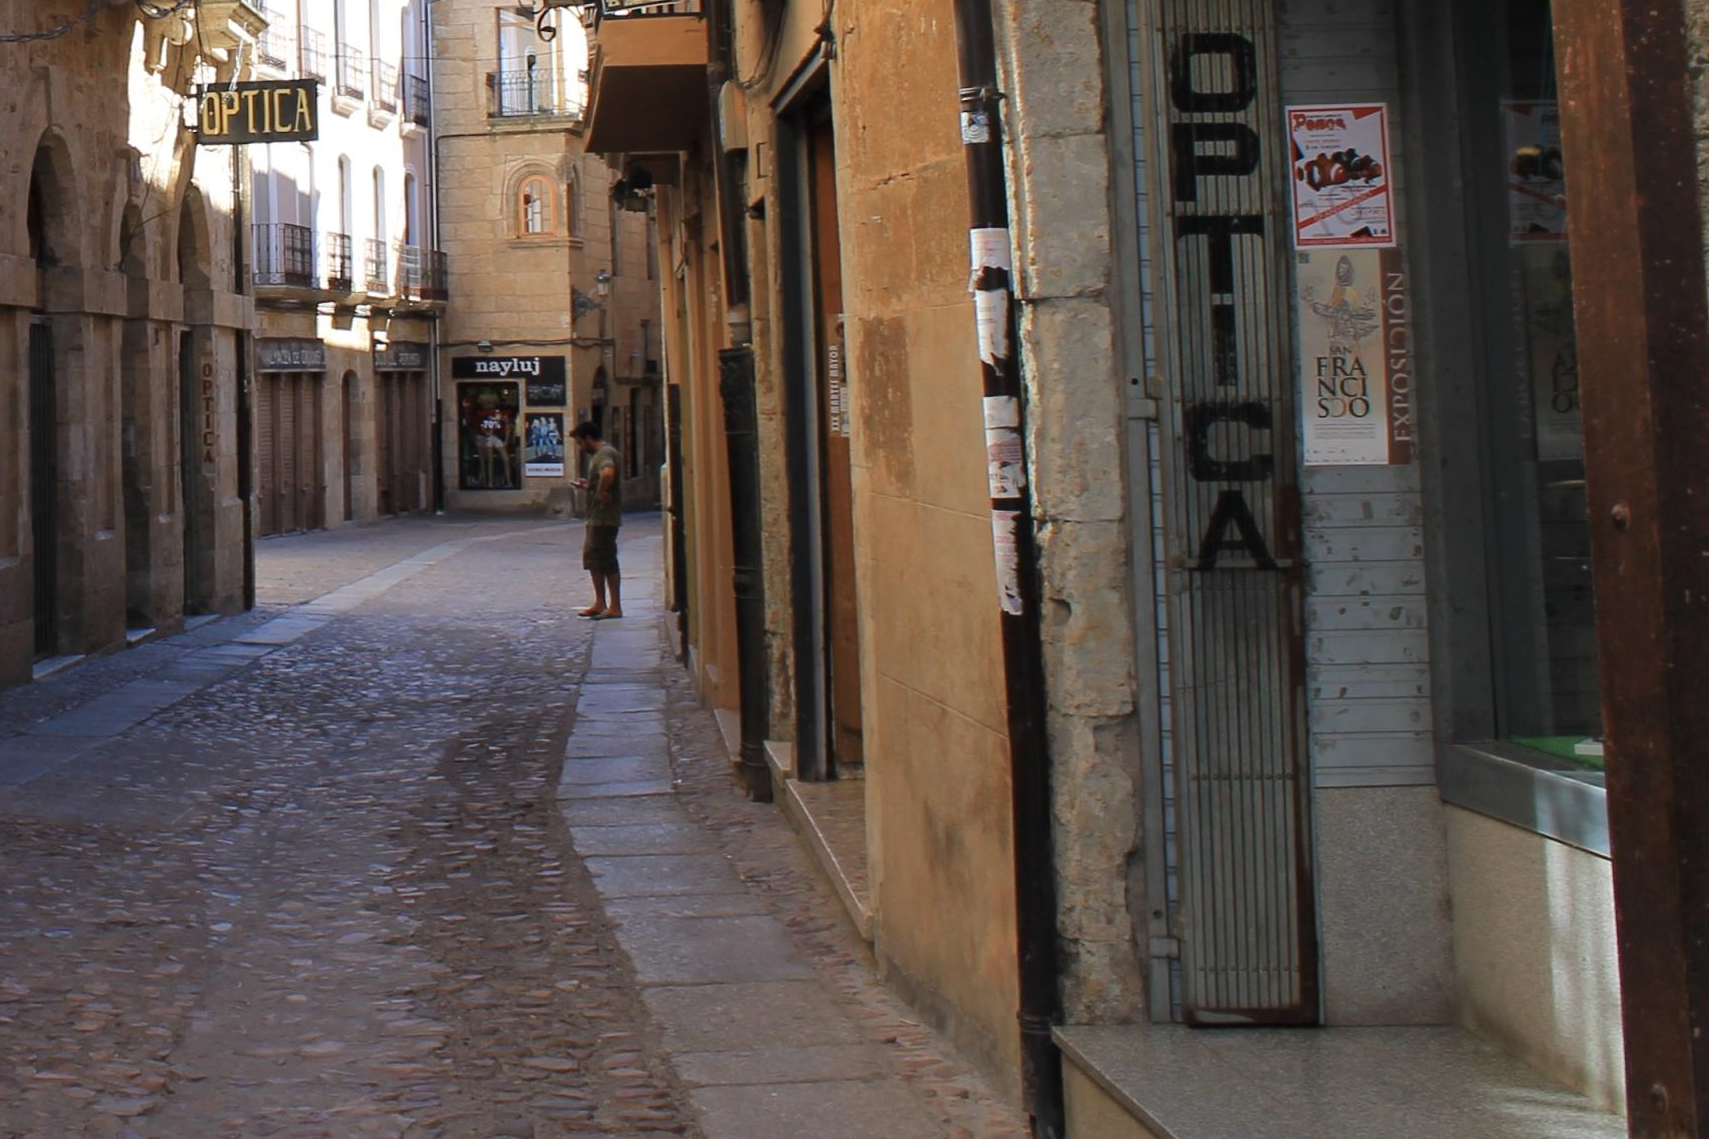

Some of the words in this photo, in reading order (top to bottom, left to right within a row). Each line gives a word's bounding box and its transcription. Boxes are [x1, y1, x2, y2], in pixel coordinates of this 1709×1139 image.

[202, 88, 312, 136] OPTICA
[1169, 32, 1276, 571] OPTICA
[1329, 345, 1352, 356] SAN
[475, 357, 540, 376] nayluj
[1316, 357, 1367, 377] FRA
[1318, 377, 1368, 397] NCI
[202, 362, 214, 463] OPTICA
